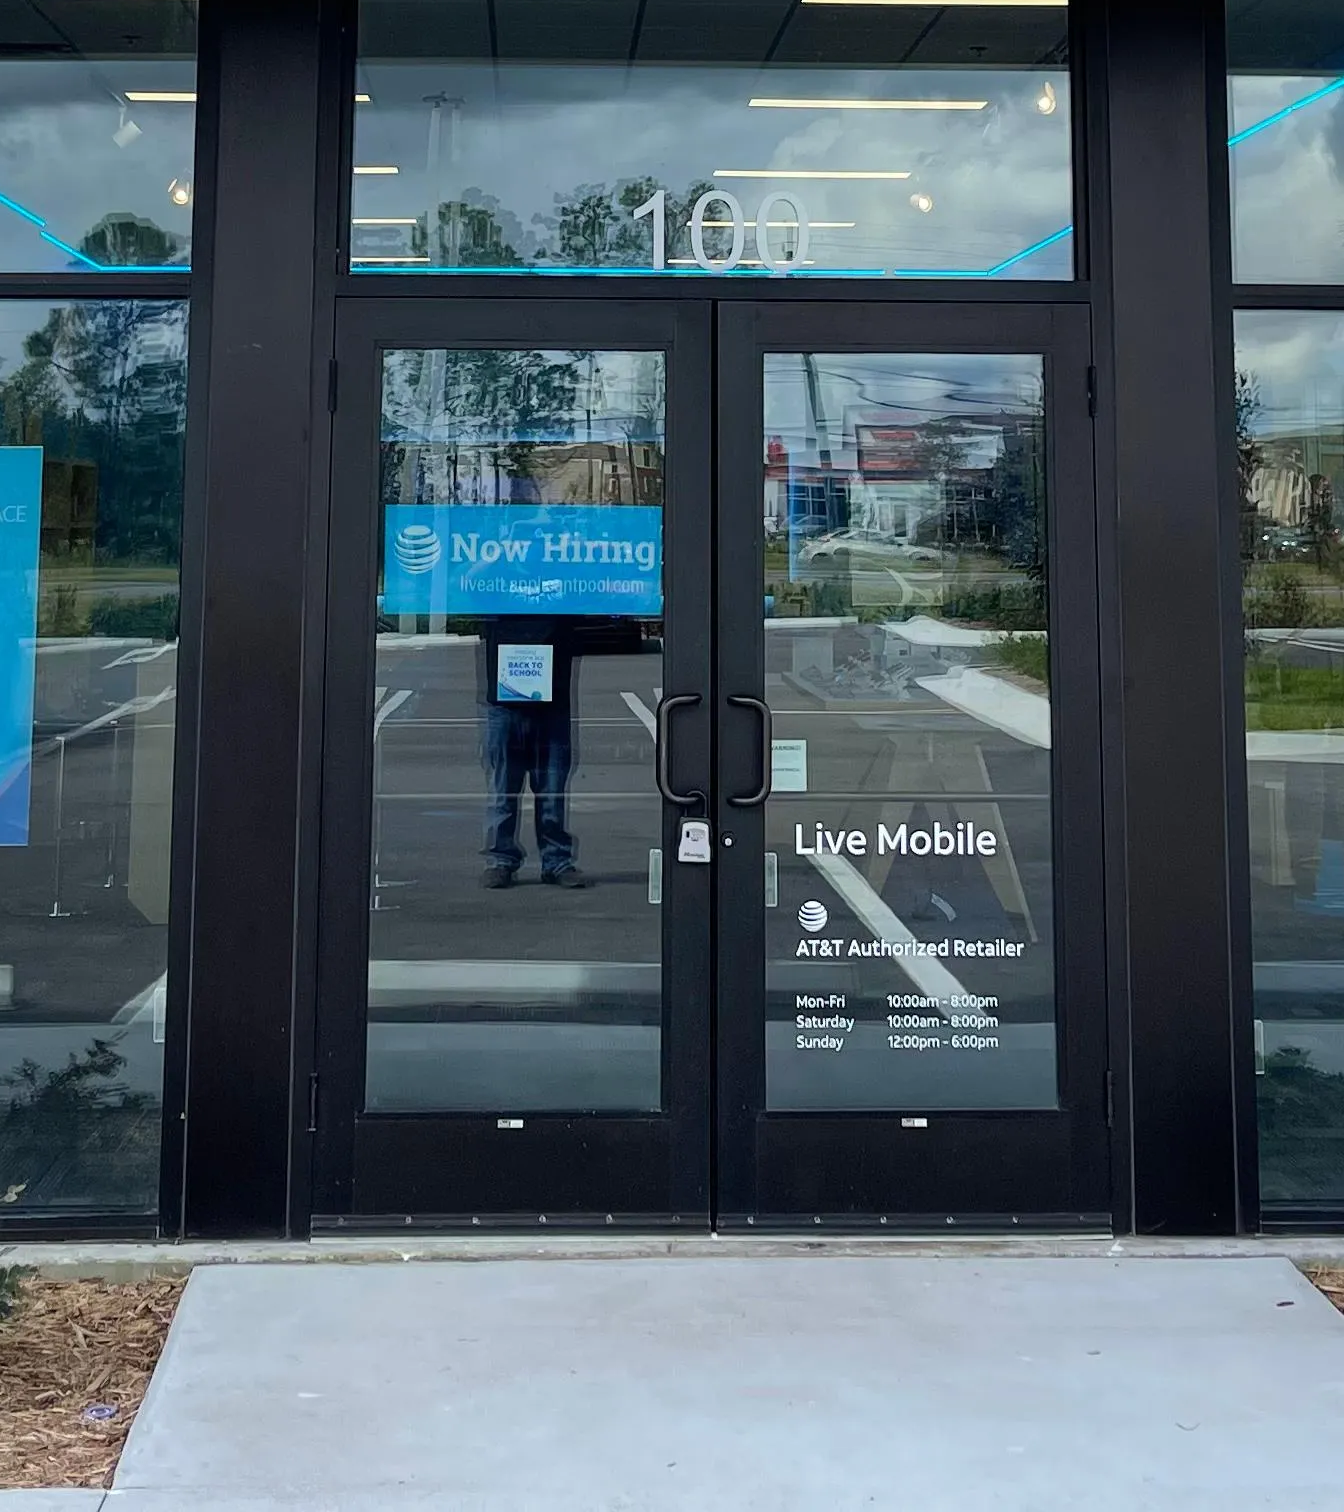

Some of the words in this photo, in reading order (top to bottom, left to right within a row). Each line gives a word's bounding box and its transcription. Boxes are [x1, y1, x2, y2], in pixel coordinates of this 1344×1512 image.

[632, 189, 810, 277] 100
[451, 532, 532, 563] Now
[542, 531, 656, 571] Hiring
[508, 661, 530, 669] BACK
[531, 661, 544, 669] TO
[509, 669, 542, 677] SCHOOL
[795, 822, 868, 856] Live
[877, 822, 998, 856] Mobile
[795, 939, 844, 958] AT&T
[847, 938, 949, 958] Authorized
[954, 938, 1025, 958] Retailer
[795, 995, 846, 1009] Mon-Fri
[886, 995, 941, 1009] 10:00am
[950, 995, 999, 1011] 8:00pm
[795, 1015, 855, 1032] Saturday
[886, 1015, 941, 1029] 10:00am
[950, 1015, 999, 1031] 8:00pm
[795, 1035, 844, 1052] Sunday
[886, 1035, 941, 1051] 12:00pm
[950, 1035, 999, 1051] 6:00pm
